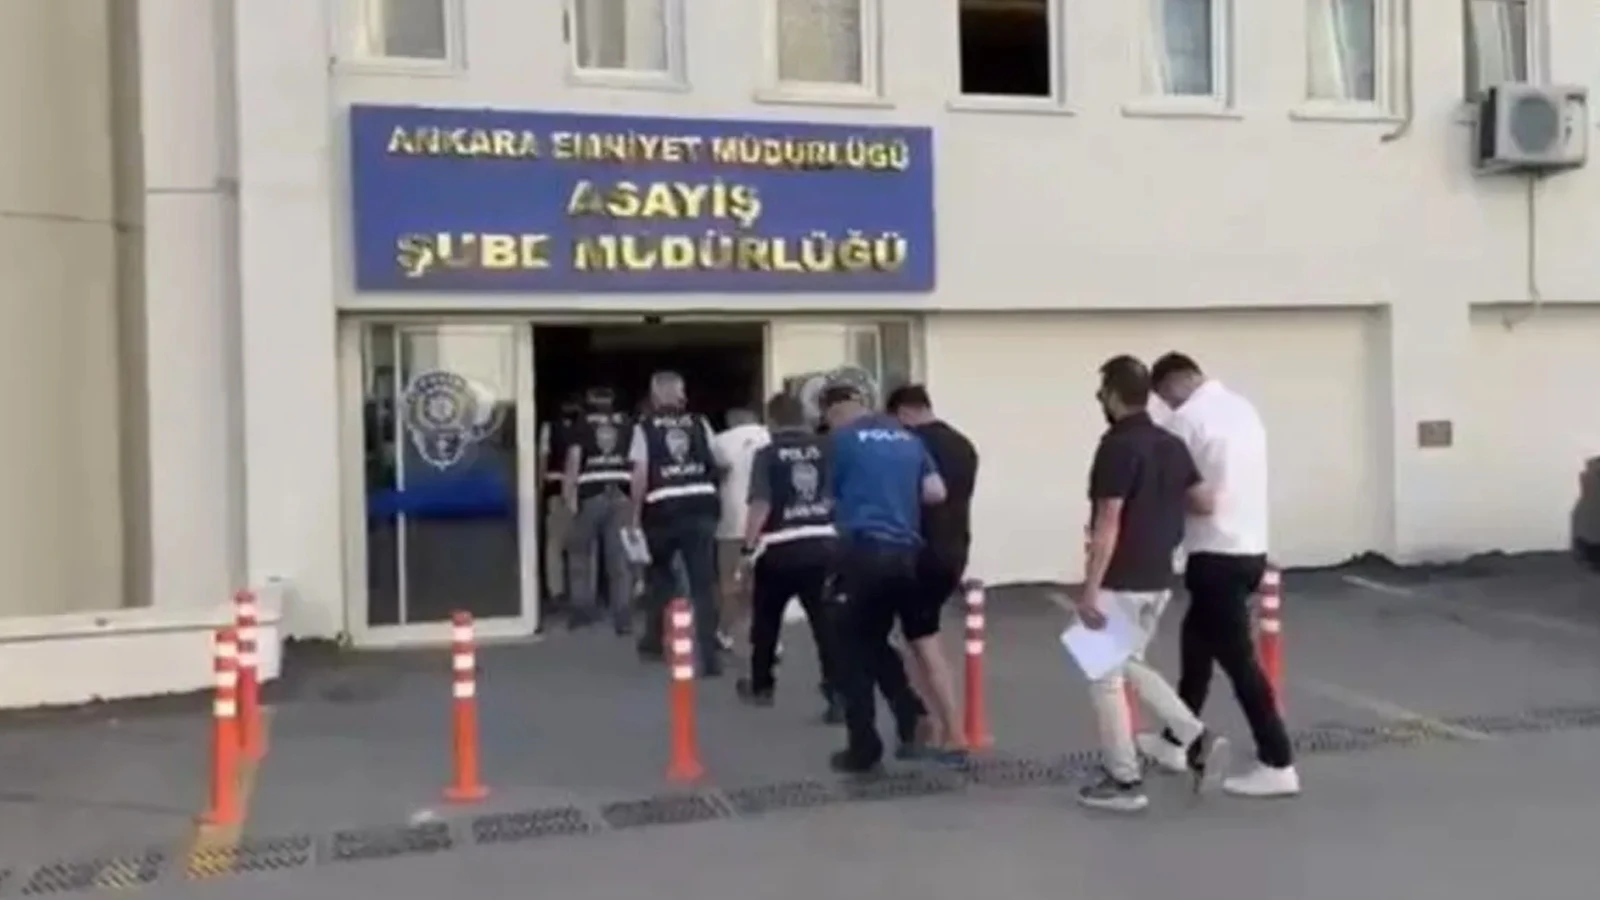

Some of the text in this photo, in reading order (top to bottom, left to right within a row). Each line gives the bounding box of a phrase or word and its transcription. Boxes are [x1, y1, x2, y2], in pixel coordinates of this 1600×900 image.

[387, 124, 539, 160] ANKARA
[566, 177, 762, 226] ASAYİŞ
[395, 231, 551, 279] ŞUBE
